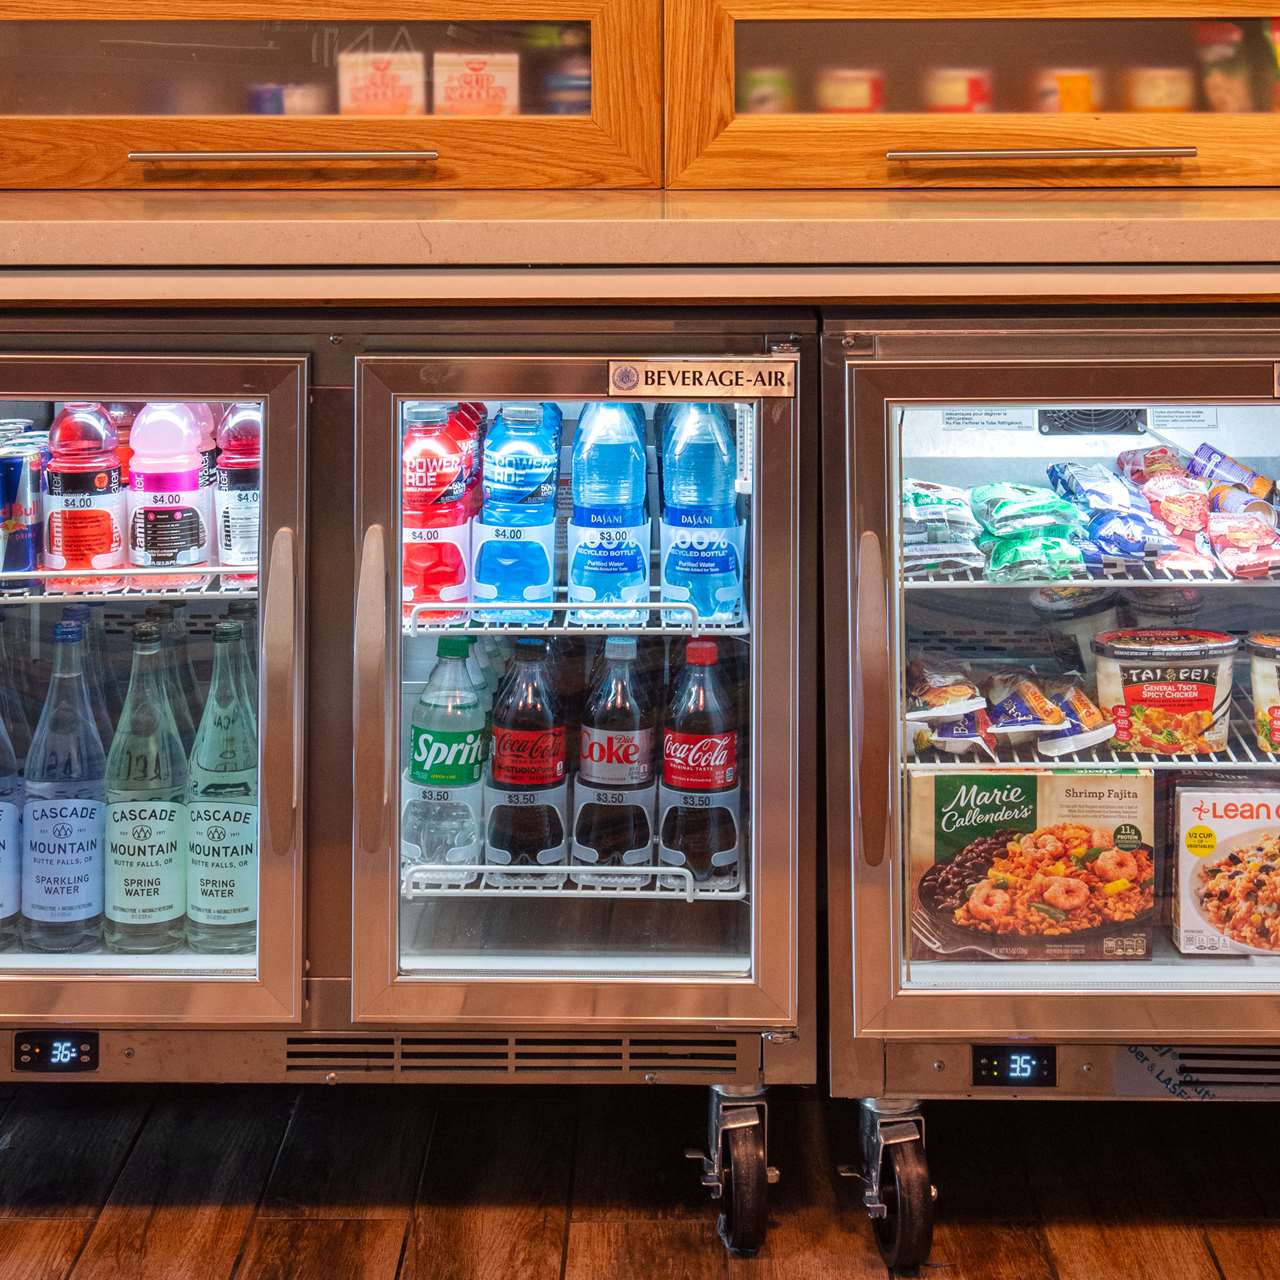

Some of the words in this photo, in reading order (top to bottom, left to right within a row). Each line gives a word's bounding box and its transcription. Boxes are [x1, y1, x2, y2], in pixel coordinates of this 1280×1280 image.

[644, 370, 786, 387] BEVERAGE-AIR
[406, 458, 462, 473] POWER
[494, 455, 551, 471] POWER
[406, 473, 437, 487] ADE
[494, 470, 525, 484] ADE
[64, 498, 92, 508] $4.00
[152, 494, 181, 504] $4.00
[591, 514, 622, 526] DASANI
[681, 514, 713, 526] DASANI
[411, 530, 439, 540] $4.00
[494, 529, 522, 540] $4.00
[599, 531, 627, 541] $3.00
[609, 560, 625, 568] Water
[699, 560, 716, 568] Water
[1129, 669, 1161, 681] TAI
[1179, 668, 1209, 681] PEI
[615, 735, 634, 744] Diet
[581, 733, 640, 765] Coke
[664, 734, 729, 768] Coca-Cola
[422, 790, 449, 801] $3.50
[508, 794, 536, 804] $3.50
[596, 793, 624, 804] $3.50
[942, 784, 1026, 813] Marie
[1065, 788, 1104, 800] Shrimp
[1107, 789, 1138, 800] Fajita
[683, 796, 711, 806] $3.50
[32, 807, 97, 821] CASCADE
[112, 808, 177, 823] CASCADE
[190, 809, 252, 824] CASCADE
[941, 805, 1032, 833] Callender's
[1120, 825, 1135, 835] 11g
[30, 839, 98, 855] MOUNTAIN
[110, 840, 178, 857] MOUNTAIN
[189, 842, 253, 857] MOUNTAIN
[33, 857, 54, 865] BUTTE
[56, 858, 81, 866] FALLS,
[114, 859, 135, 867] BUTTE
[136, 860, 162, 868] FALLS,
[192, 859, 211, 868] BUTTE
[213, 861, 237, 869] FALLS,
[239, 859, 249, 868] OR
[35, 875, 90, 886] SPARKLING
[124, 877, 161, 888] SPRING
[200, 878, 236, 888] SPRING
[43, 884, 80, 895] WATER
[124, 887, 160, 897] WATER
[200, 887, 234, 898] WATER
[50, 1041, 72, 1063] 36
[1009, 1055, 1031, 1077] 35
